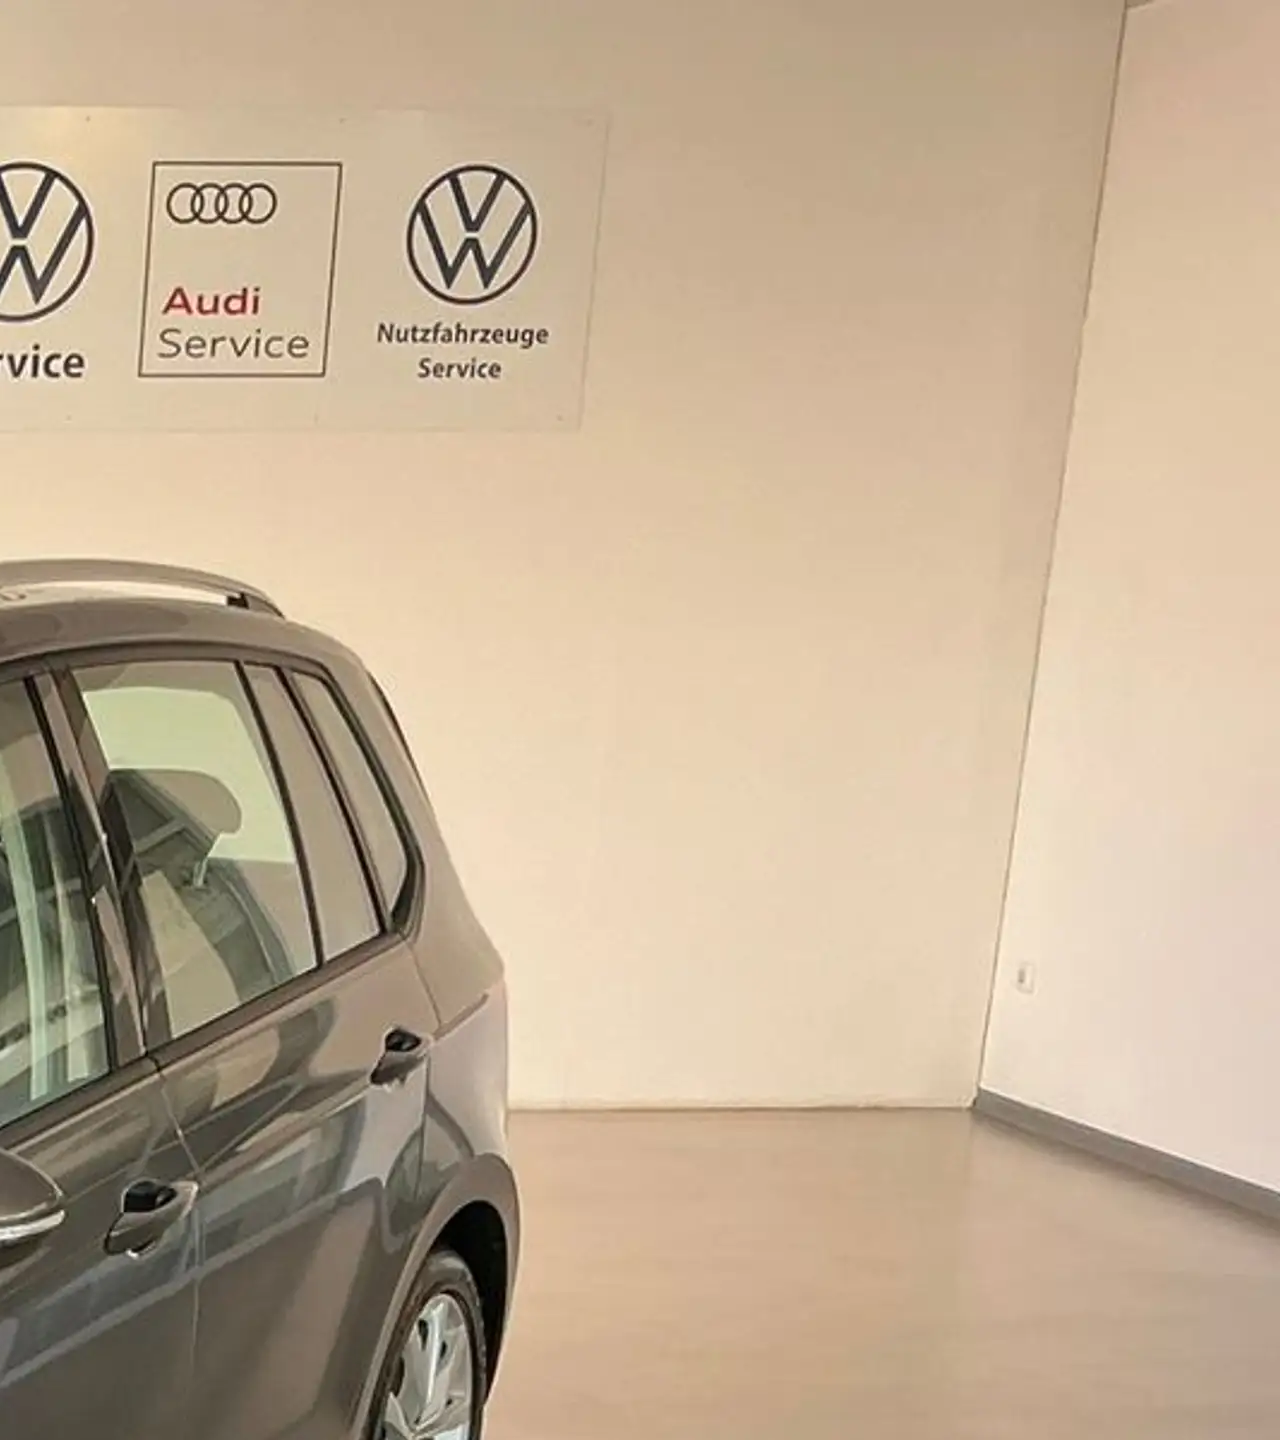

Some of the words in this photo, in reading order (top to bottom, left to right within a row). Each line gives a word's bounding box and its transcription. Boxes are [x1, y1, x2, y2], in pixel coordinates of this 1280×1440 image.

[162, 286, 261, 317] Audi
[156, 328, 311, 360] Service
[376, 322, 550, 350] Nutzfahrzeuge
[416, 357, 503, 380] Service
